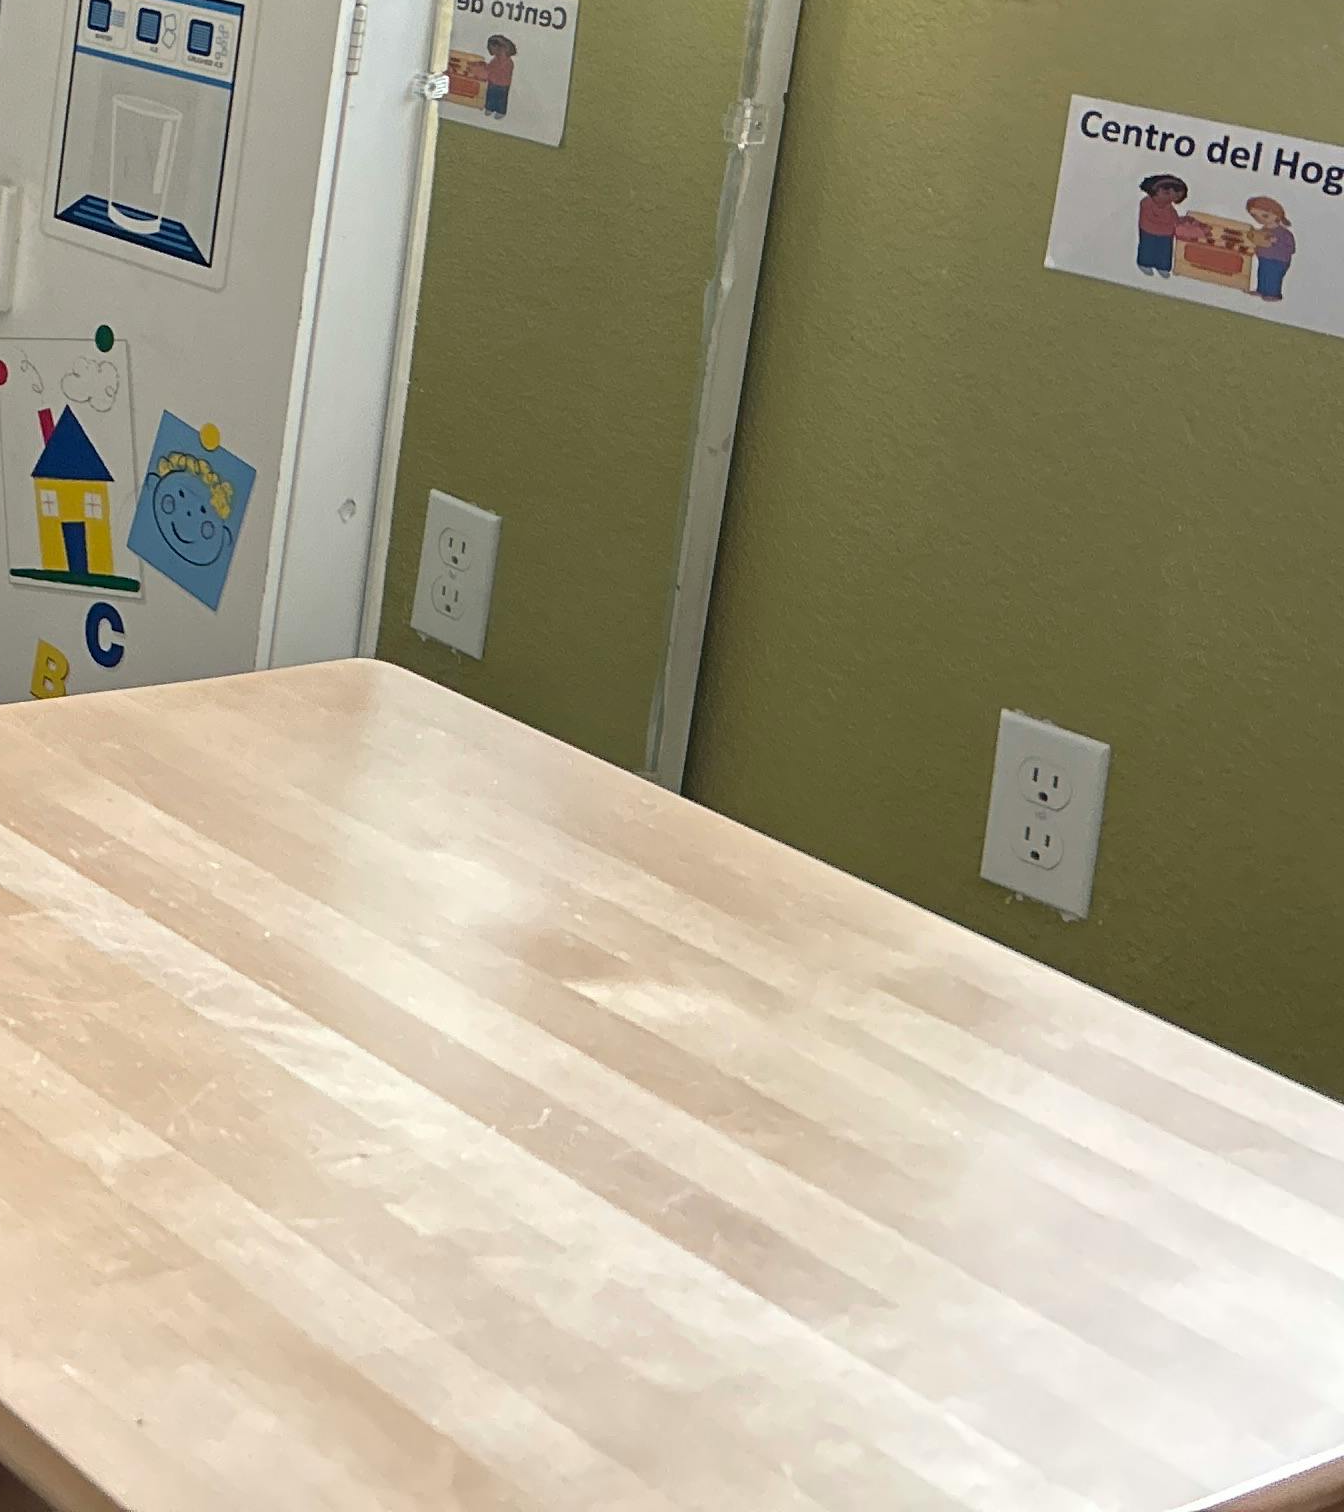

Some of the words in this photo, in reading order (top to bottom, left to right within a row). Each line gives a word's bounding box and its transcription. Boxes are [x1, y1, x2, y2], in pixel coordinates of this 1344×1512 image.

[1079, 109, 1196, 158] Centro
[1206, 135, 1264, 172] del
[1272, 147, 1344, 197] Hog
[29, 638, 70, 700] B
[85, 601, 125, 669] C
